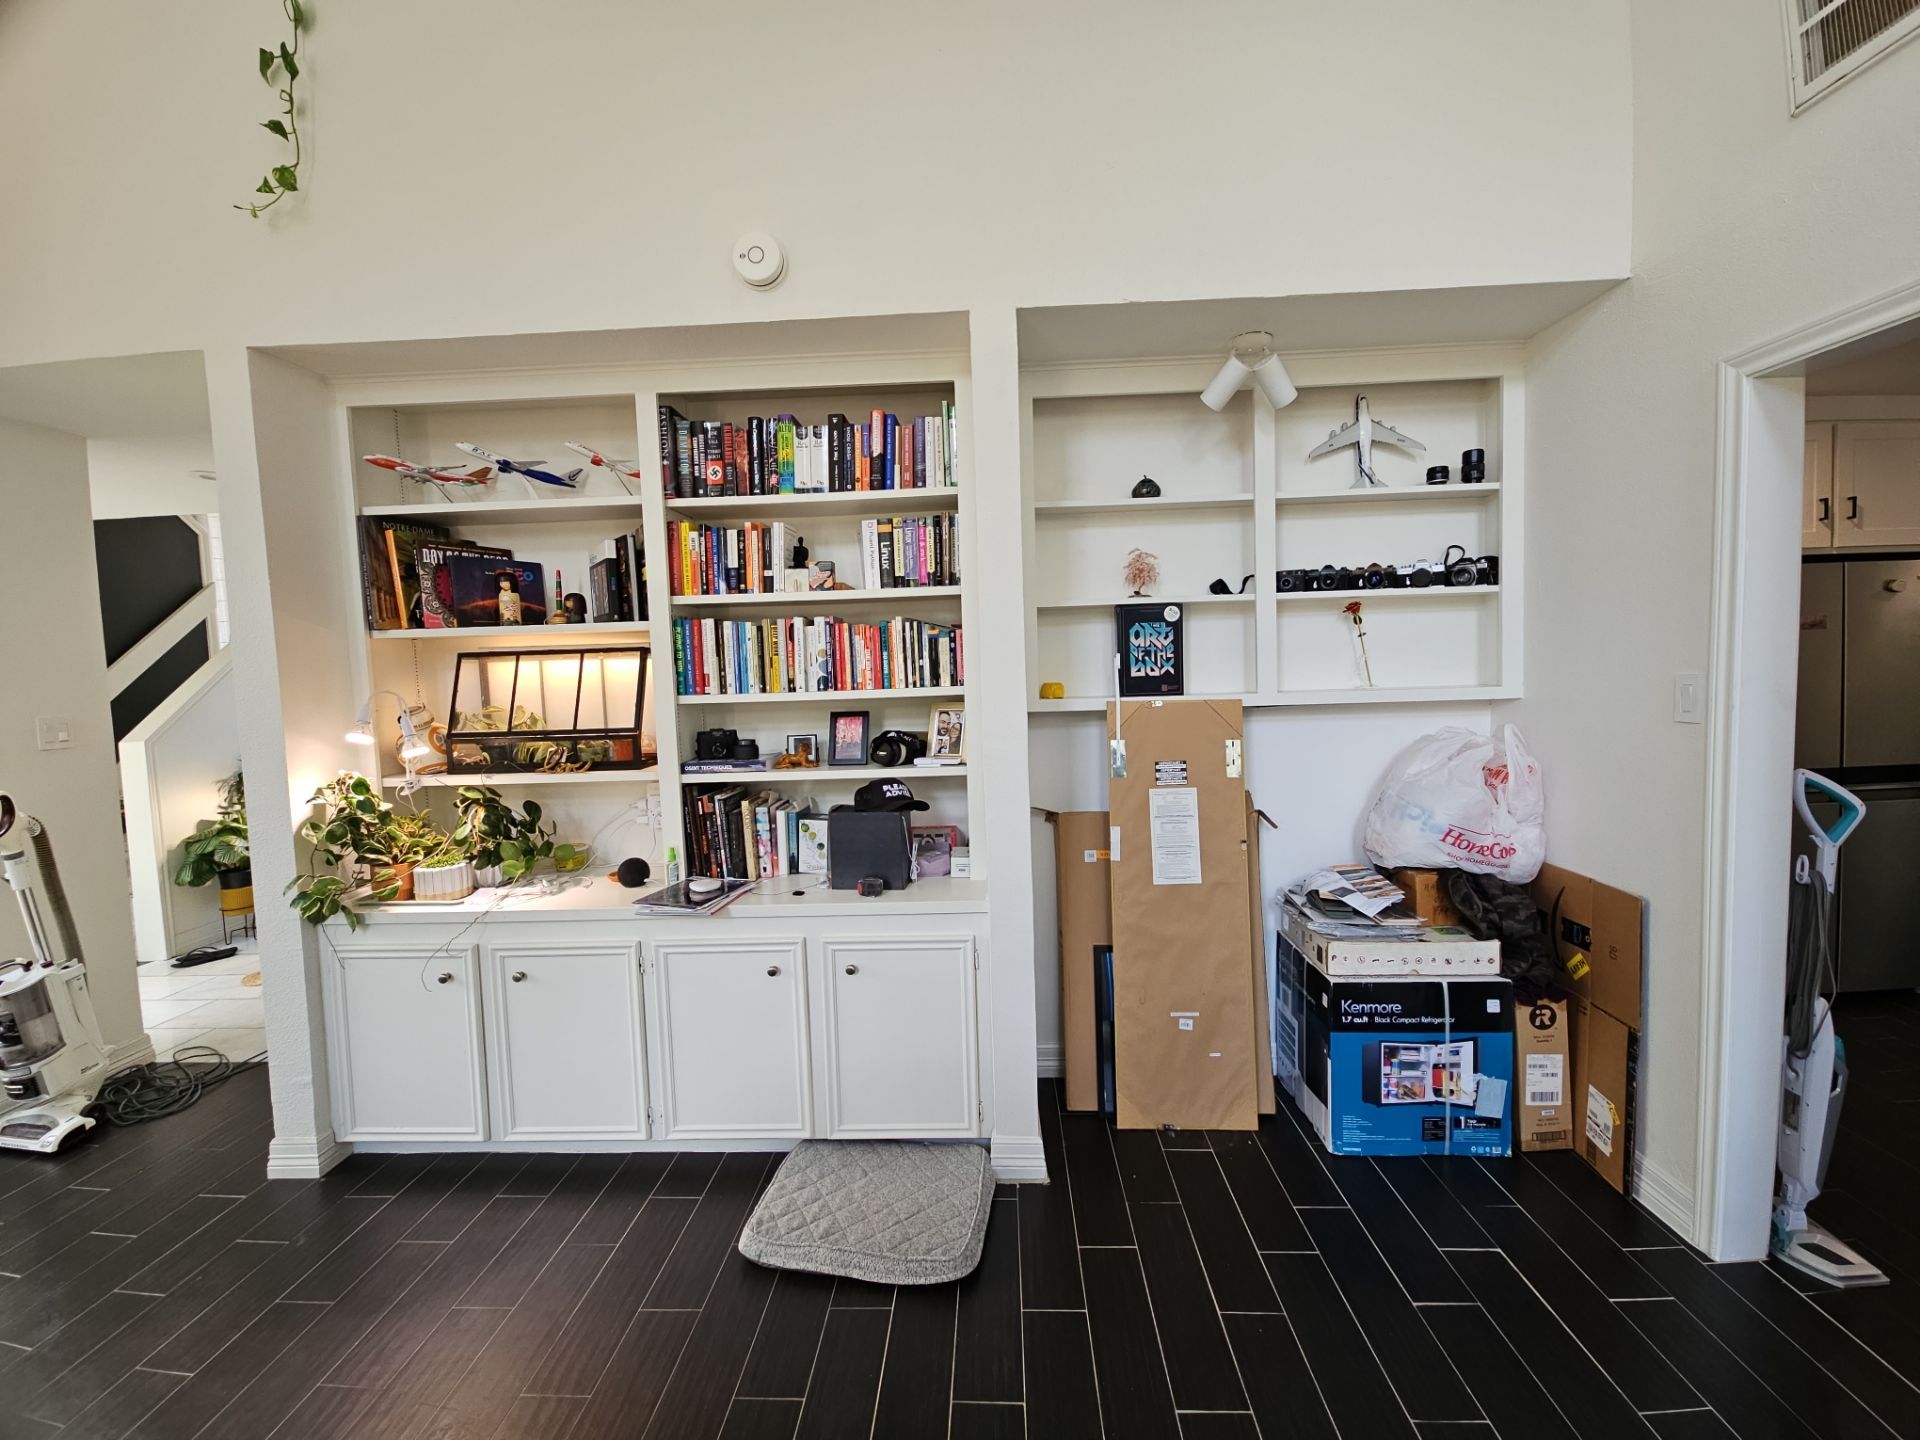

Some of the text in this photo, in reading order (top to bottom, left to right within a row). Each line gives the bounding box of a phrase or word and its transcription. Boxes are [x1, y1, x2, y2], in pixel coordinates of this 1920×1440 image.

[659, 407, 669, 457] FASHION
[679, 430, 689, 475] DOMINION
[905, 527, 915, 544] Linux
[422, 548, 444, 565] DAY
[881, 541, 890, 570] Linux
[675, 626, 683, 650] PLAYING
[677, 651, 683, 659] TO
[1341, 999, 1403, 1014] Kenmore
[1392, 1016, 1420, 1025] Compact
[1421, 1016, 1456, 1025] Refrigeraor
